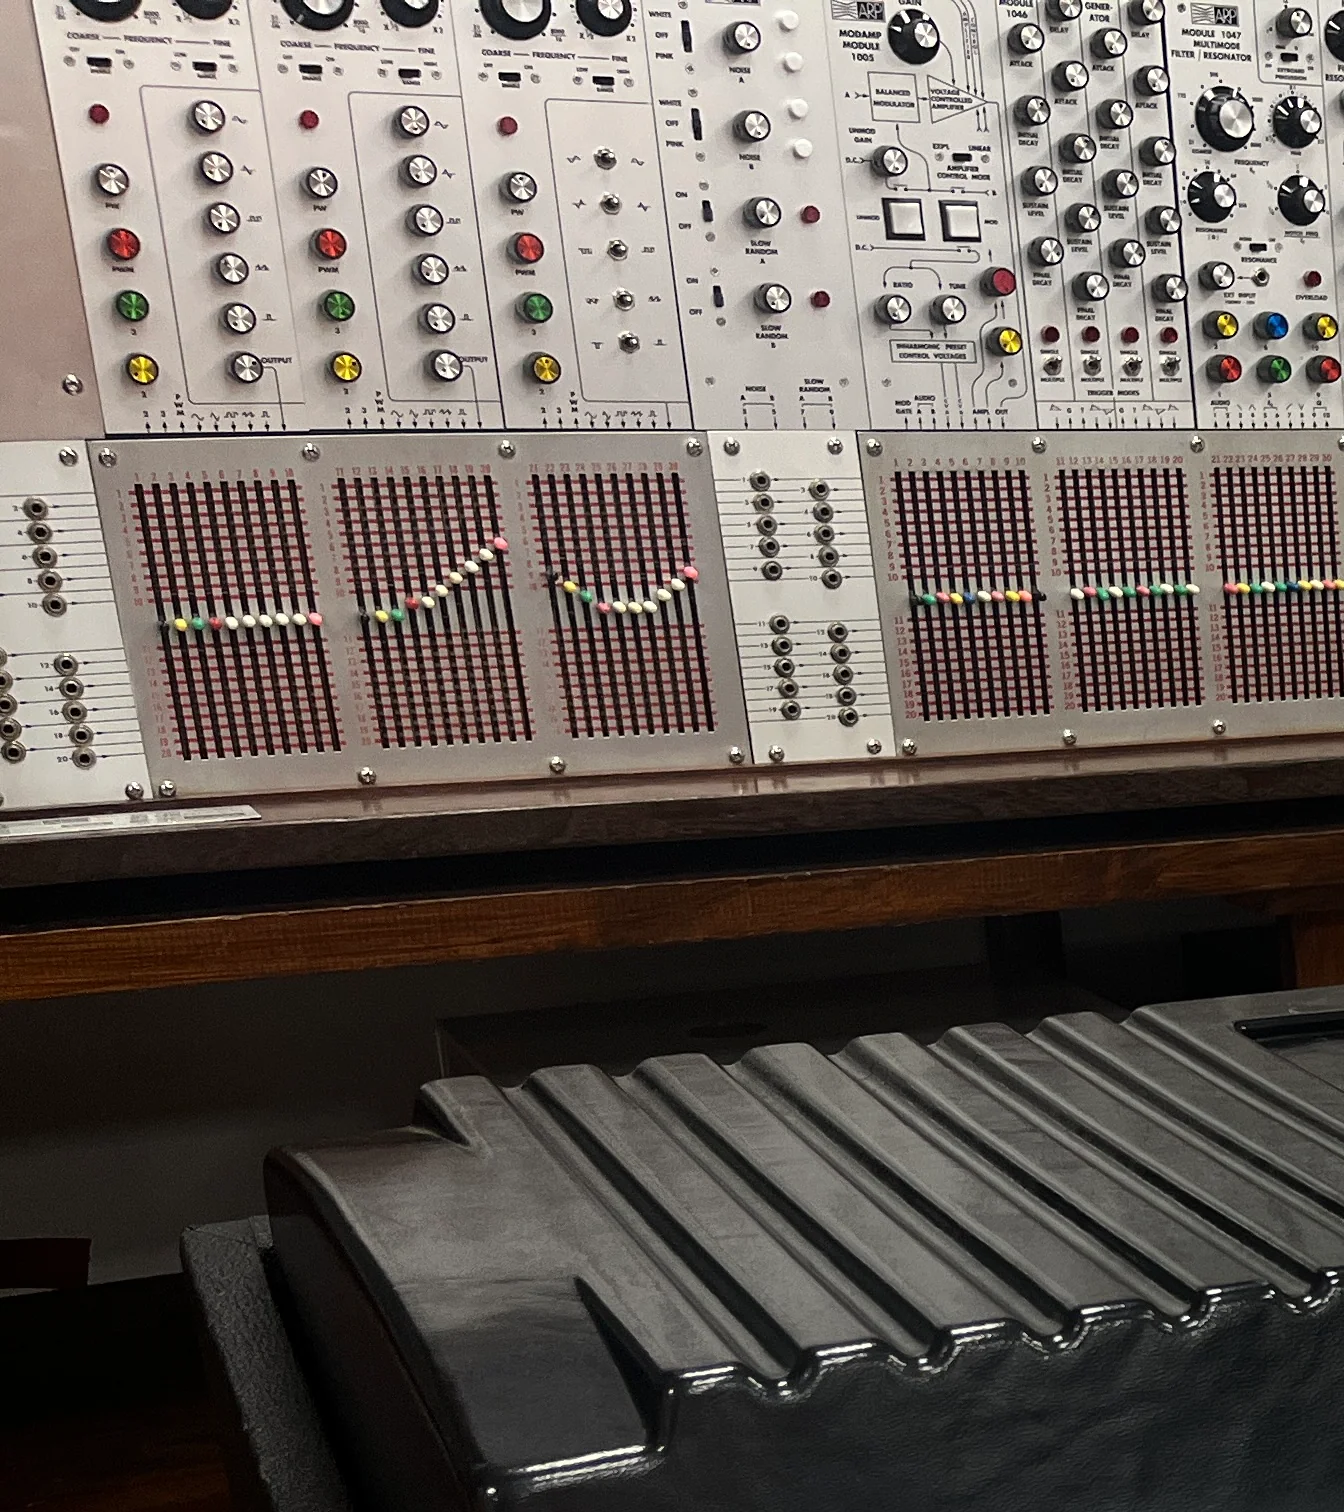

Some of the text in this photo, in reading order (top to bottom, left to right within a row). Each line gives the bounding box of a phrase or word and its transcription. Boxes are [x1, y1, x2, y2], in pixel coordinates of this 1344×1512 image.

[1006, 10, 1028, 18] 1046
[1089, 14, 1110, 23] ATOR
[839, 29, 881, 38] MODAMP
[1182, 29, 1241, 39] MODULE 1047
[842, 41, 880, 50] MODULE
[1193, 41, 1240, 50] MULTIMODE
[1171, 51, 1252, 62] FILTER RESONATOR
